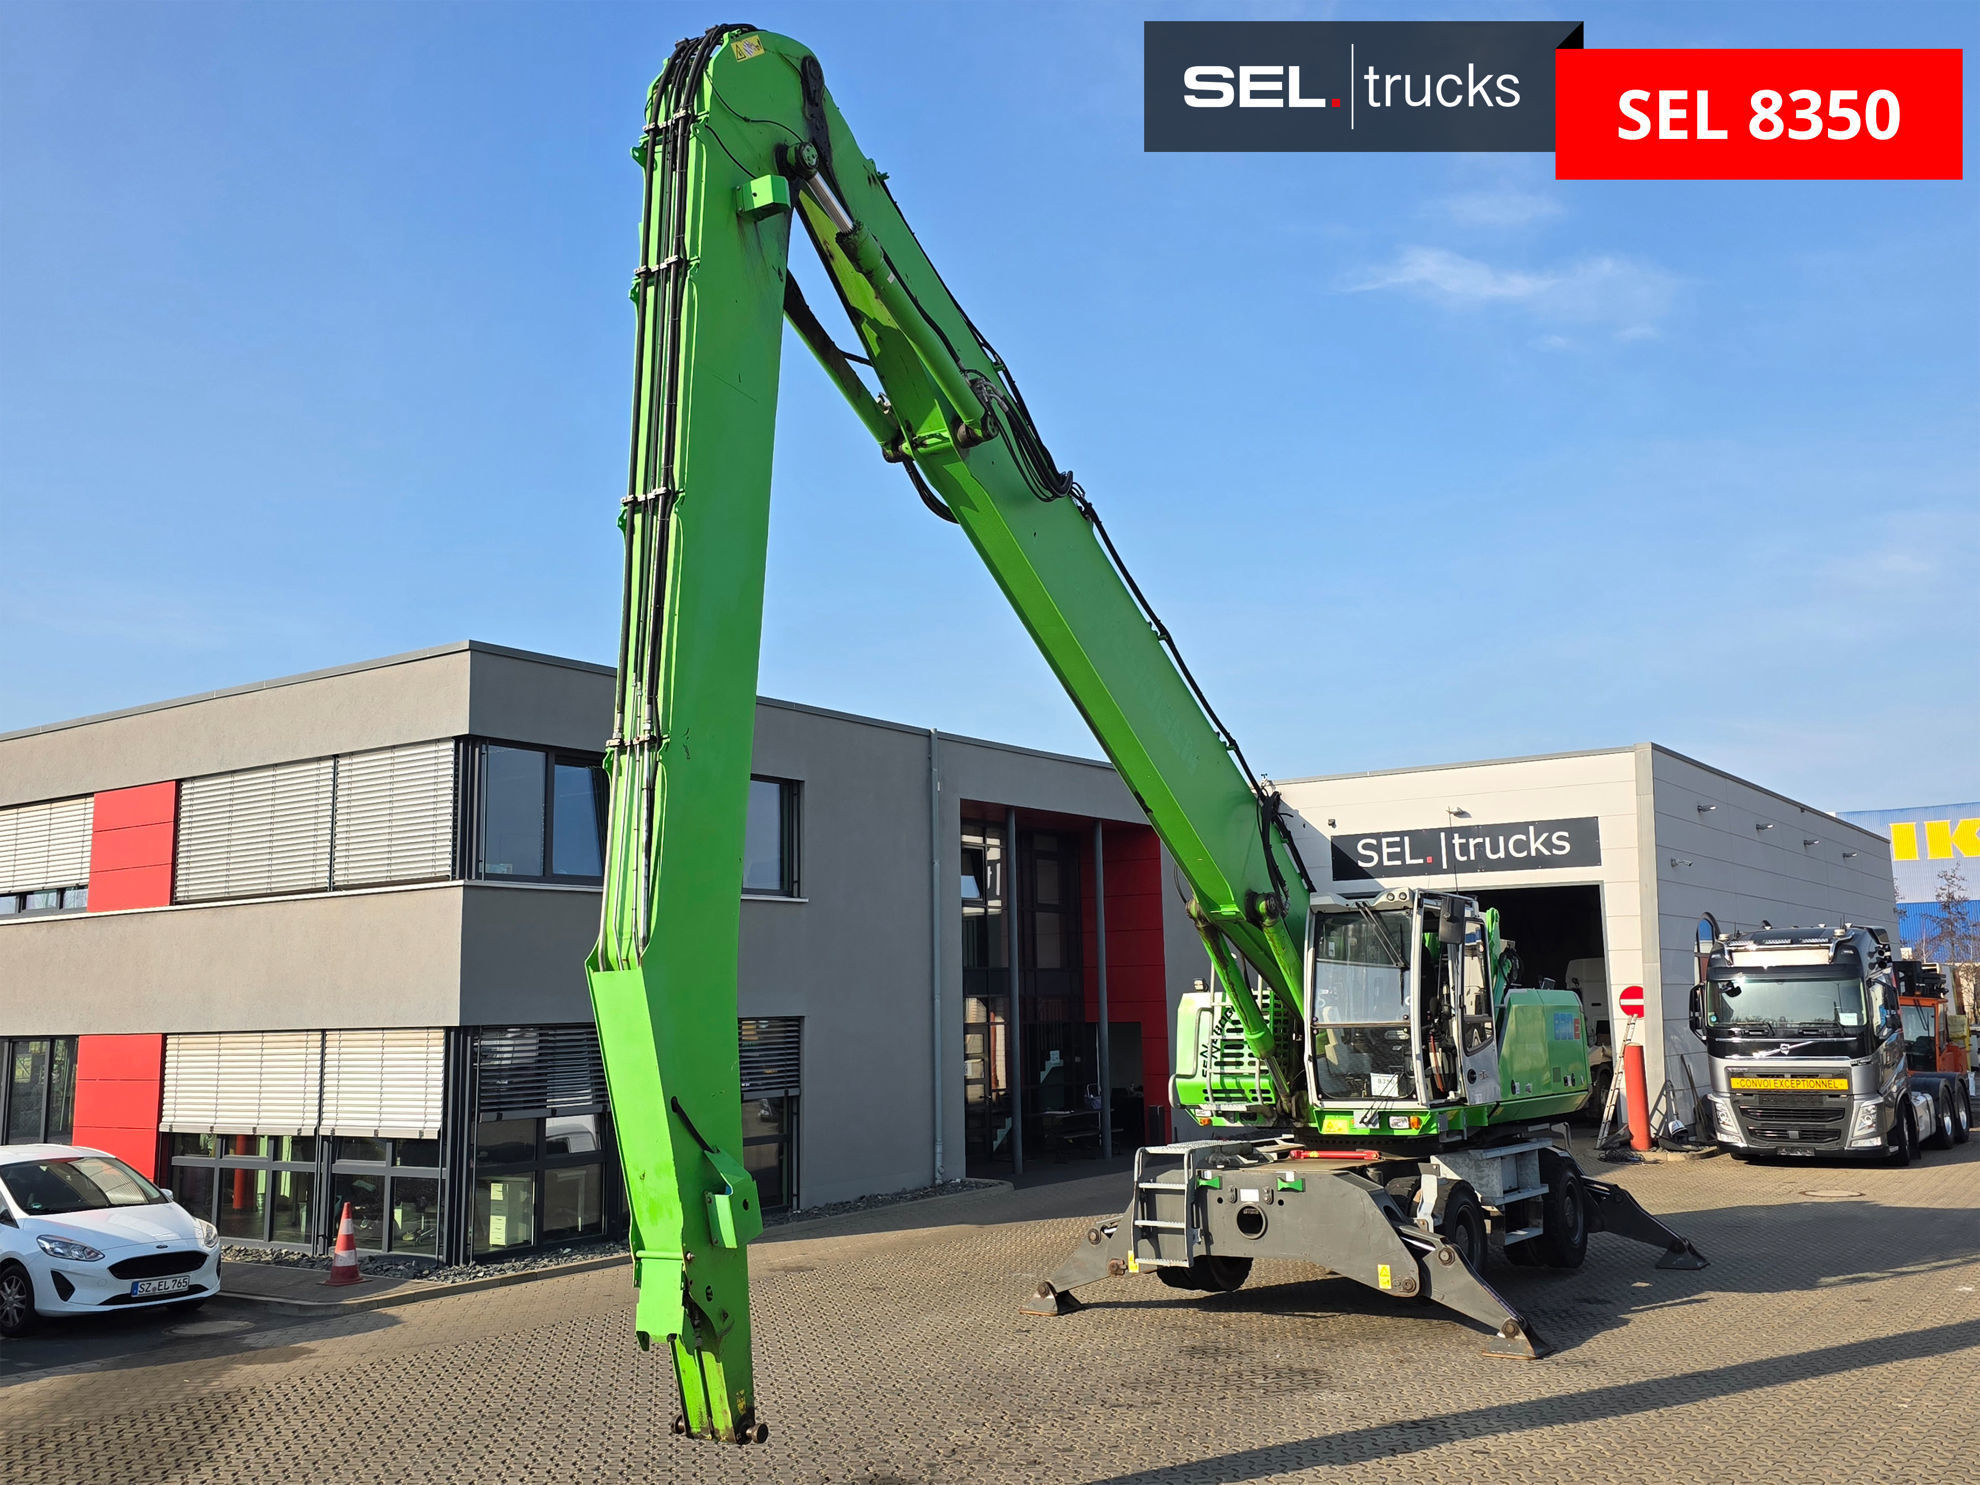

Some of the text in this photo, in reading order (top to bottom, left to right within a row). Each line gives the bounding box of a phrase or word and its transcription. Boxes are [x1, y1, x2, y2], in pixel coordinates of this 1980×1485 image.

[1452, 826, 1571, 862] trucks
[1739, 1079, 1839, 1089] CONVOI EXCEPTIONNEL
[138, 1278, 188, 1293] SZ EL 765
